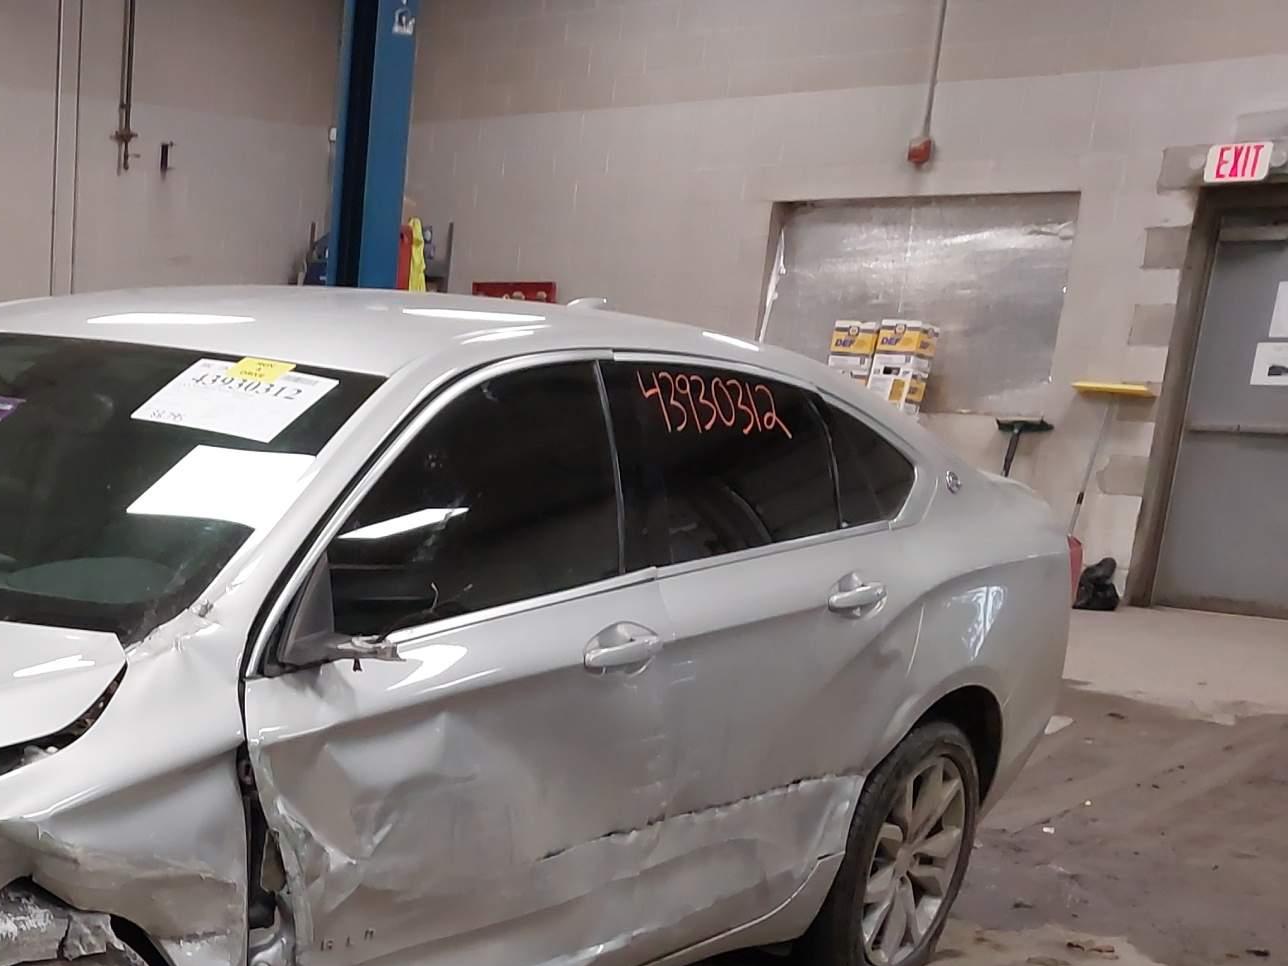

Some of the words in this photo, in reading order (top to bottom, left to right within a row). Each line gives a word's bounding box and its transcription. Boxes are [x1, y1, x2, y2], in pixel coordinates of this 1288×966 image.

[1215, 144, 1265, 178] EXIT
[192, 373, 302, 400] 43930312
[636, 370, 793, 440] 43930312
